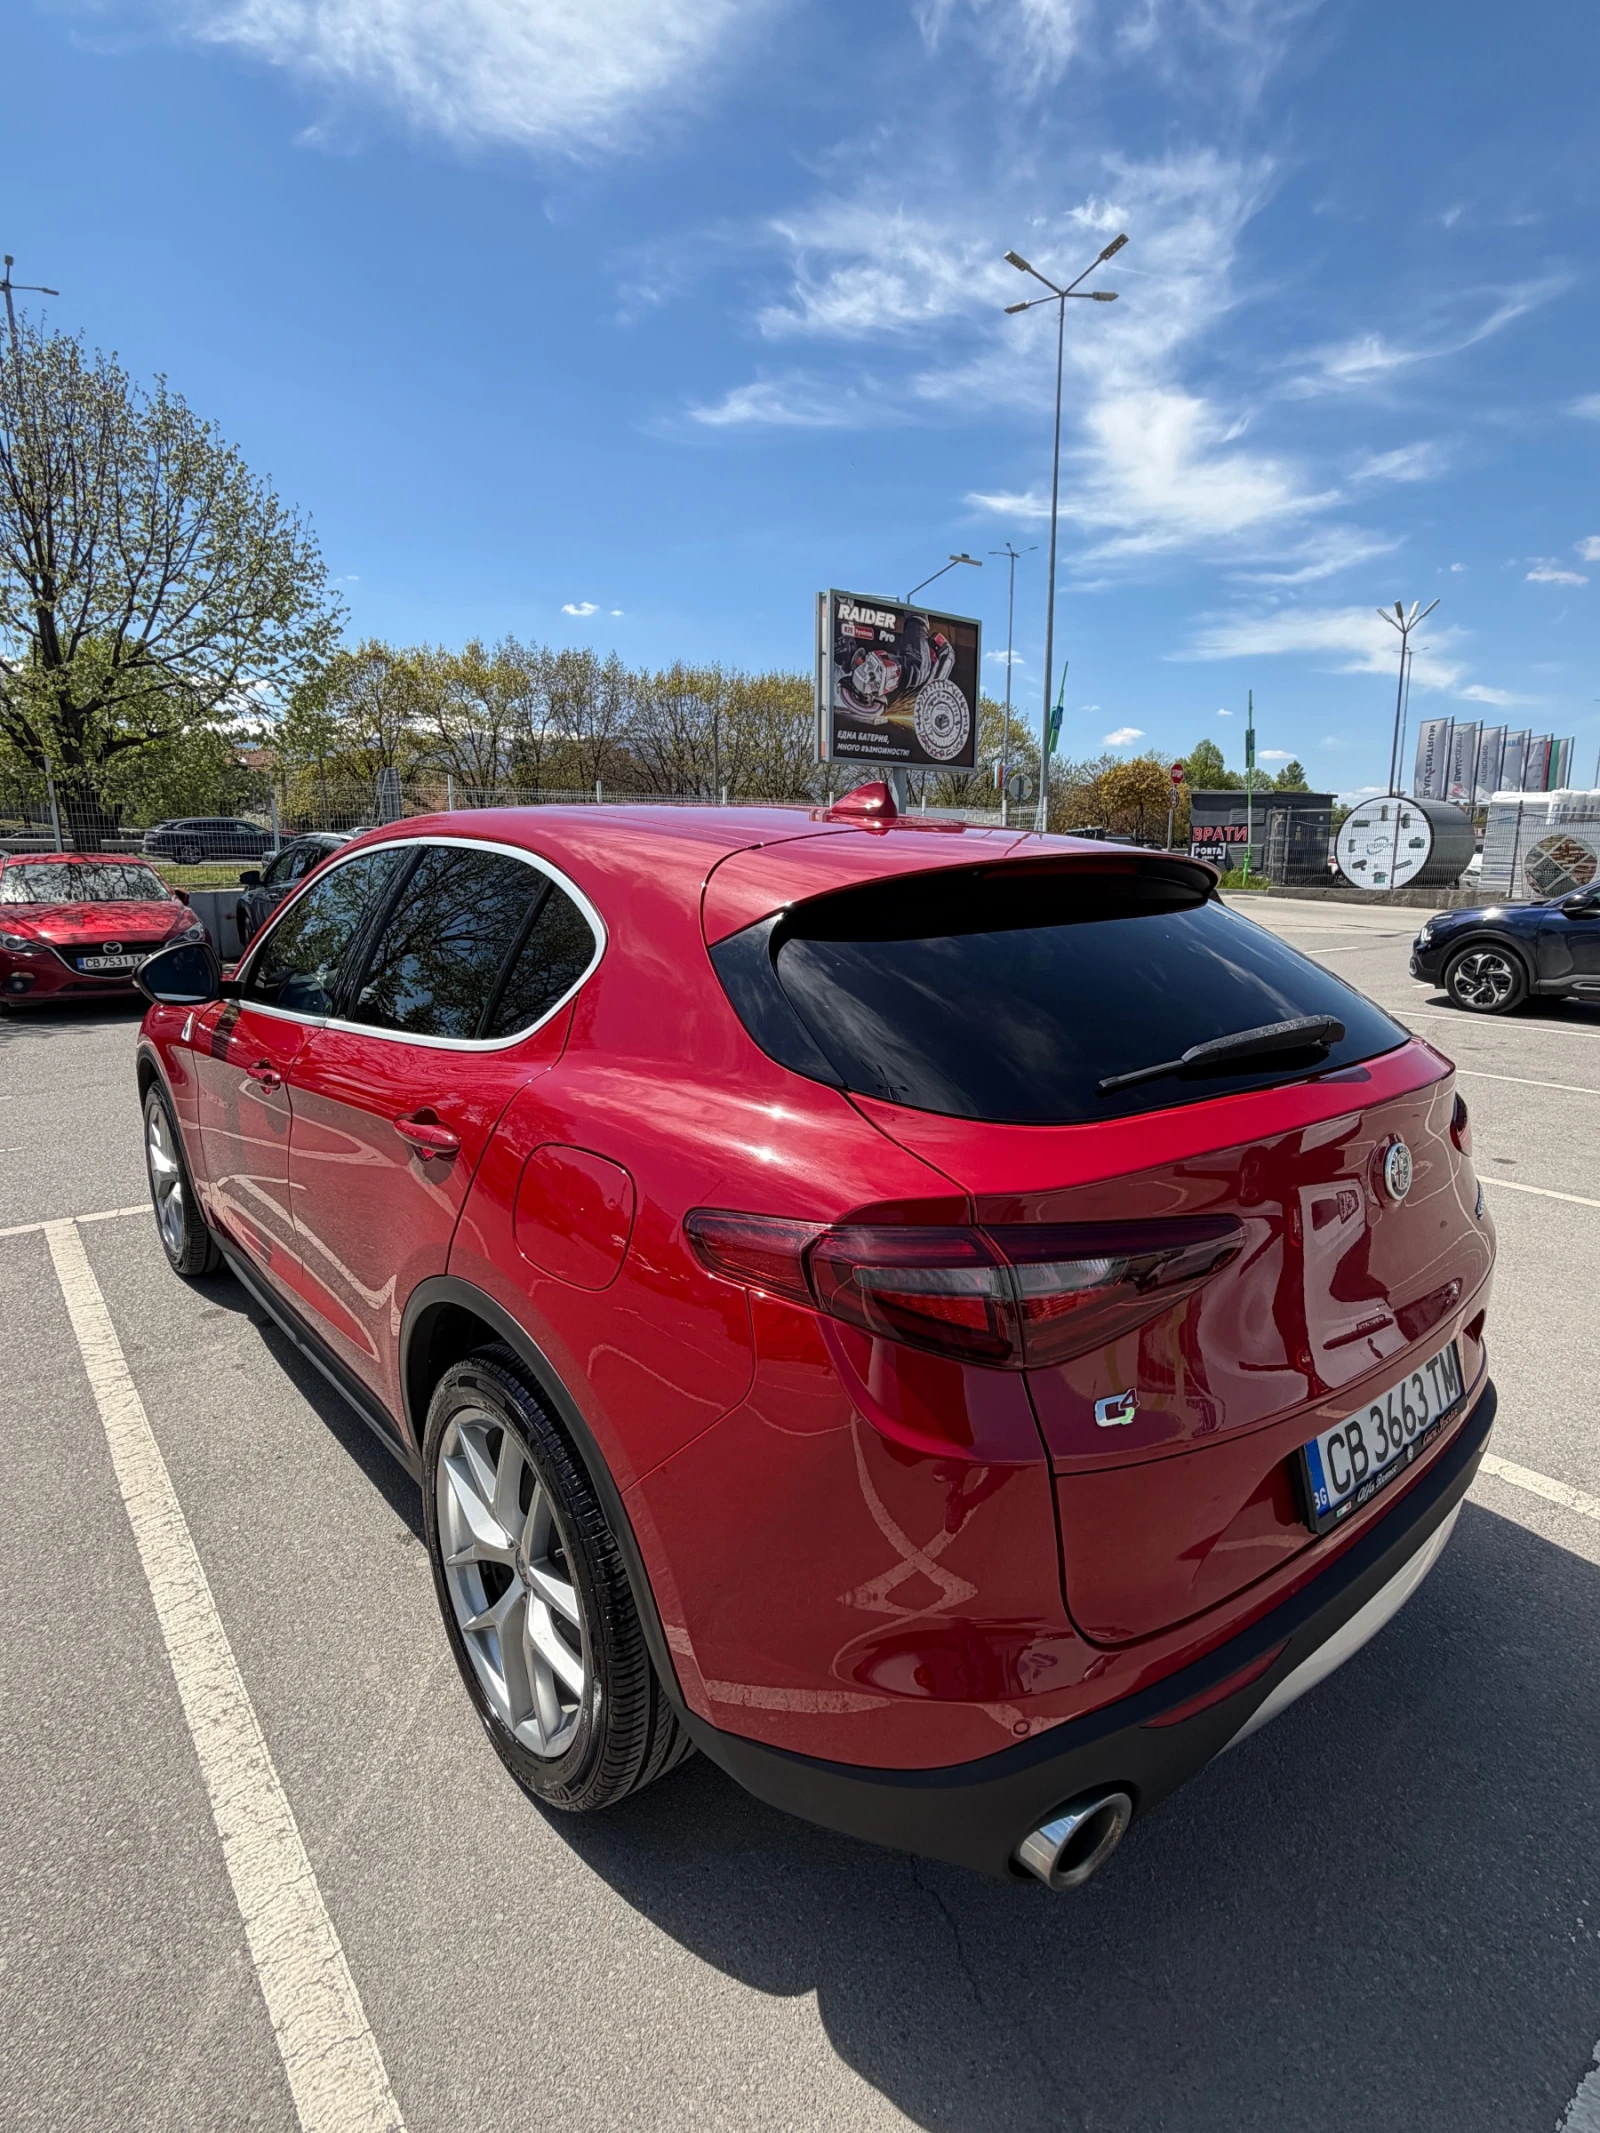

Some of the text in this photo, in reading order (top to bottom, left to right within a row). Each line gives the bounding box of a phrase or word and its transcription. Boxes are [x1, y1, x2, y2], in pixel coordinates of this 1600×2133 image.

[838, 603, 896, 629] RAIDER
[855, 628, 873, 637] System
[879, 630, 895, 643] Pro
[837, 730, 890, 744] ЕДНА БАТЕРИЯ,
[837, 743, 910, 756] МНОГО ВЪЗМОЖНОСТИ!
[1172, 769, 1183, 778] STOP
[1192, 826, 1248, 842] ВРАТИ
[85, 959, 101, 968] CB
[102, 957, 128, 967] 7531
[1327, 1421, 1369, 1494] CB
[1370, 1373, 1429, 1463] 3663
[1426, 1346, 1459, 1411] TM
